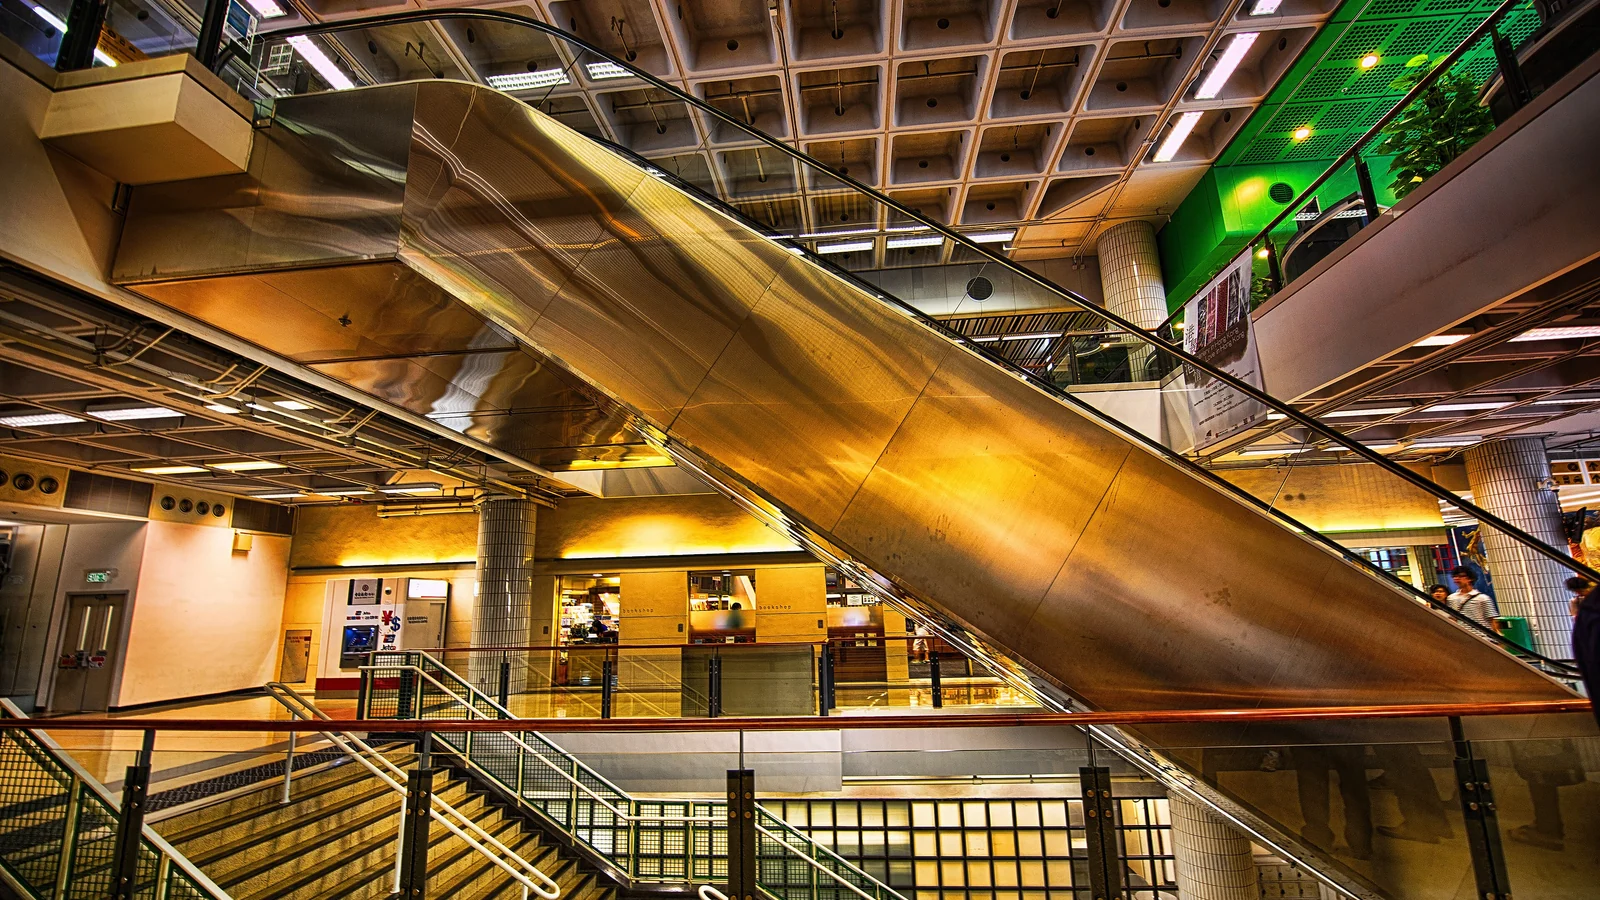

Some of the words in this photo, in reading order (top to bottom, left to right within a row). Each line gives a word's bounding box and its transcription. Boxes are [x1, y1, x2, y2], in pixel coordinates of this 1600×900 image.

[1204, 351, 1216, 363] Love
[1220, 339, 1233, 352] Hong
[1232, 331, 1246, 344] Kong
[1214, 336, 1227, 348] Hong
[1226, 327, 1240, 340] Kong
